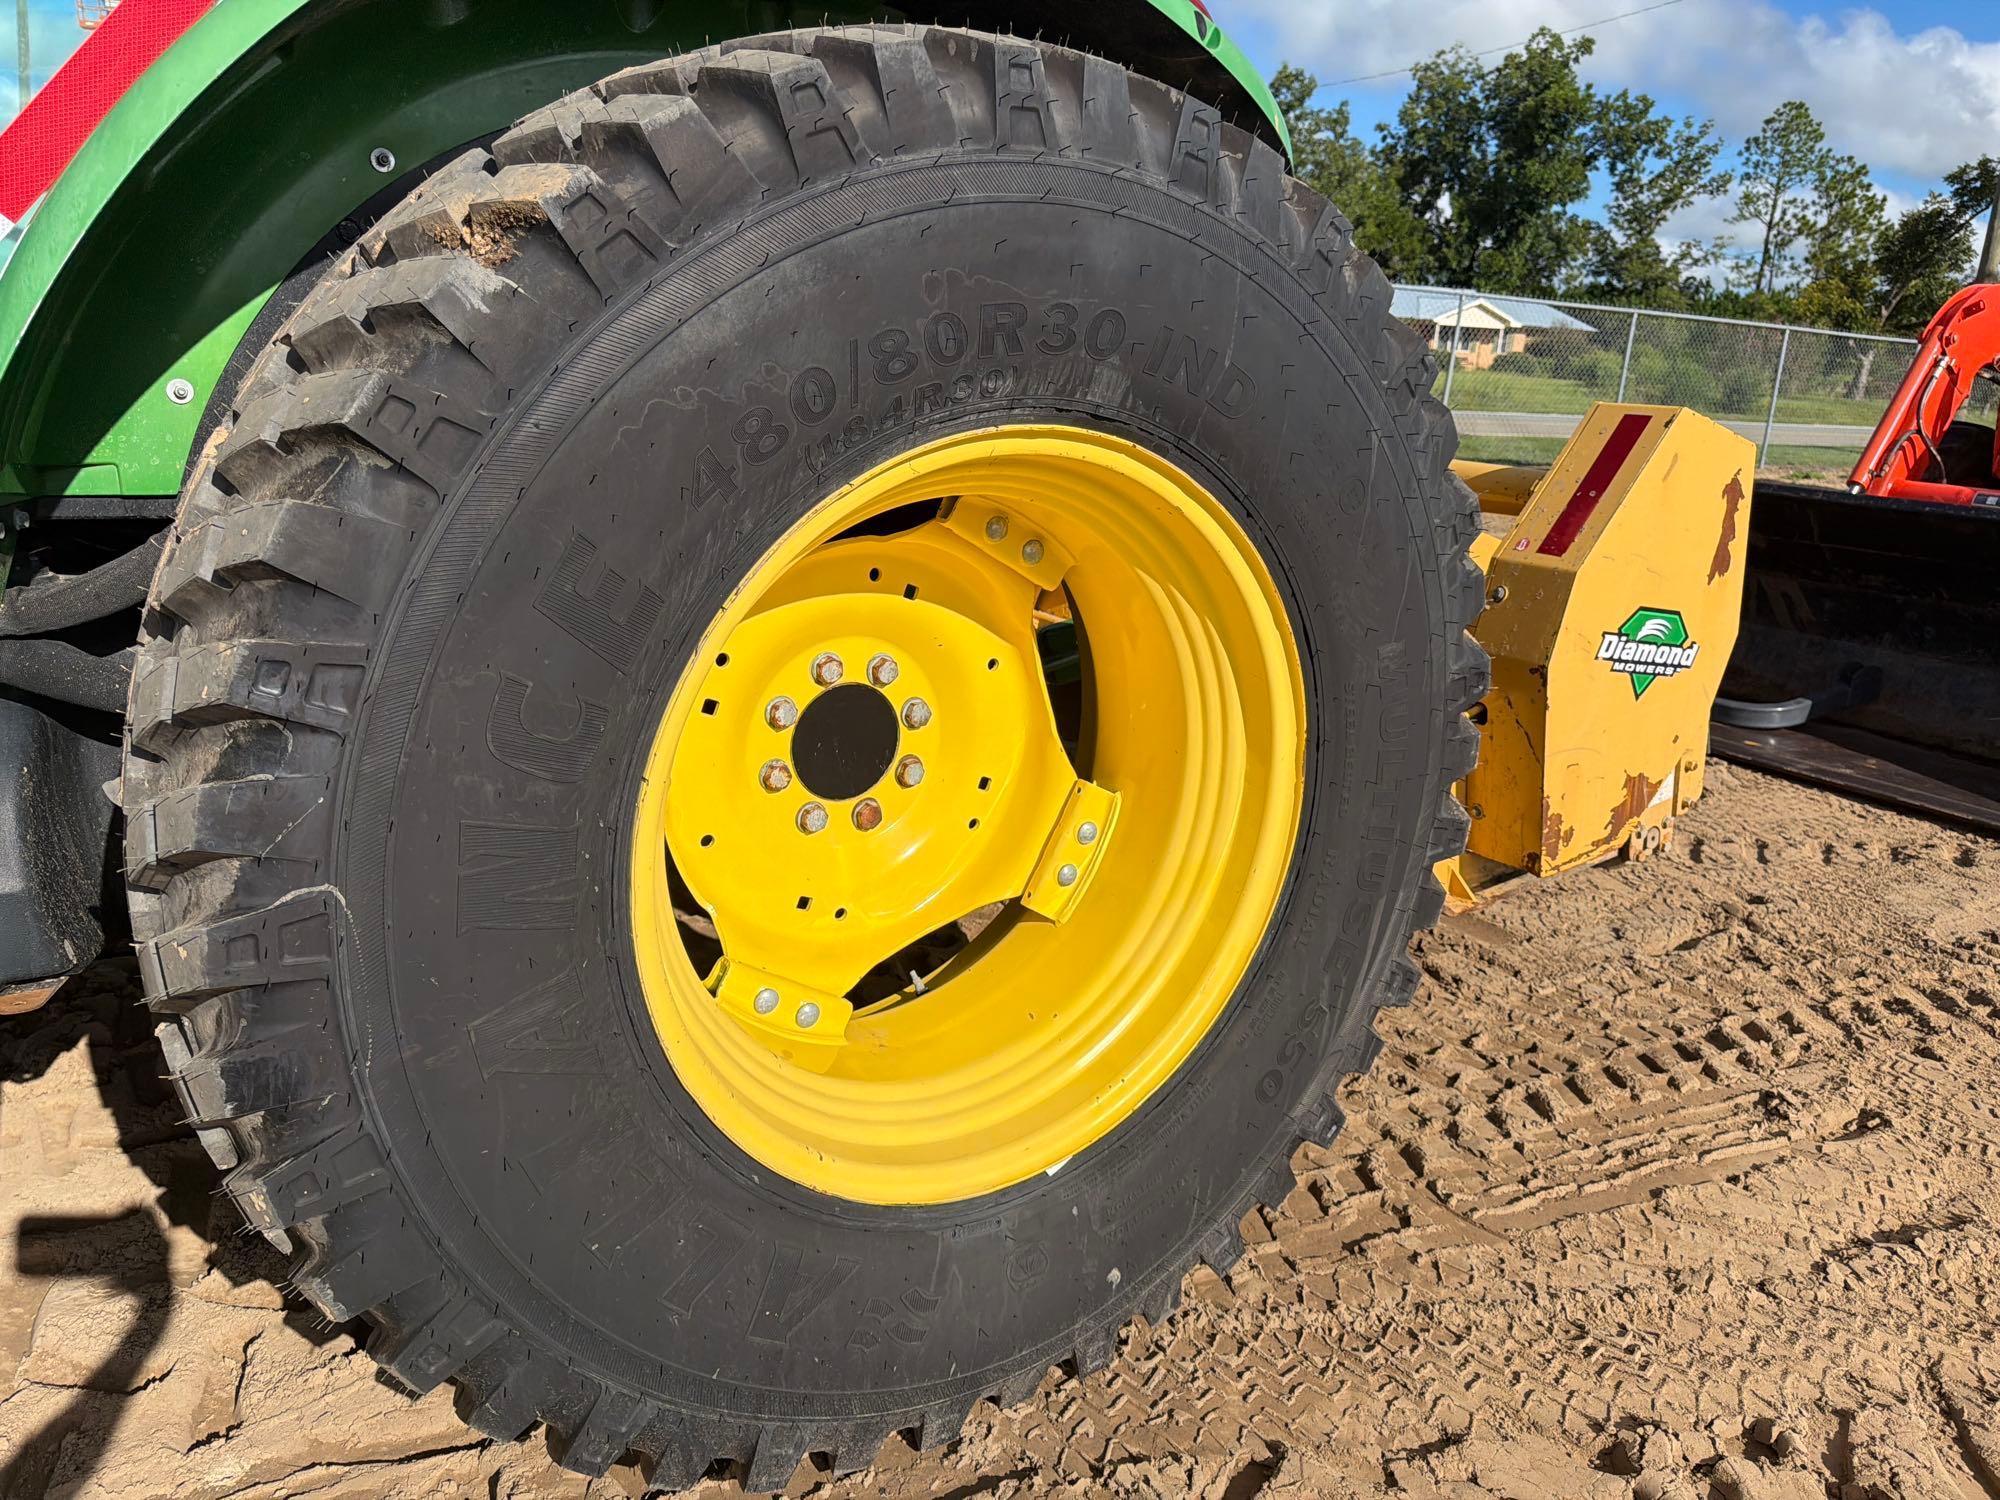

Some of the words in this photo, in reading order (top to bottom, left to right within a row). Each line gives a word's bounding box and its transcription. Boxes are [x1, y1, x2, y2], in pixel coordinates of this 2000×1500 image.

[688, 301, 1127, 512] 480/80R30
[1142, 324, 1259, 420] IND
[1597, 634, 1699, 667] Diamond
[1613, 661, 1675, 675] MOWERS
[1254, 998, 1330, 1105] 550
